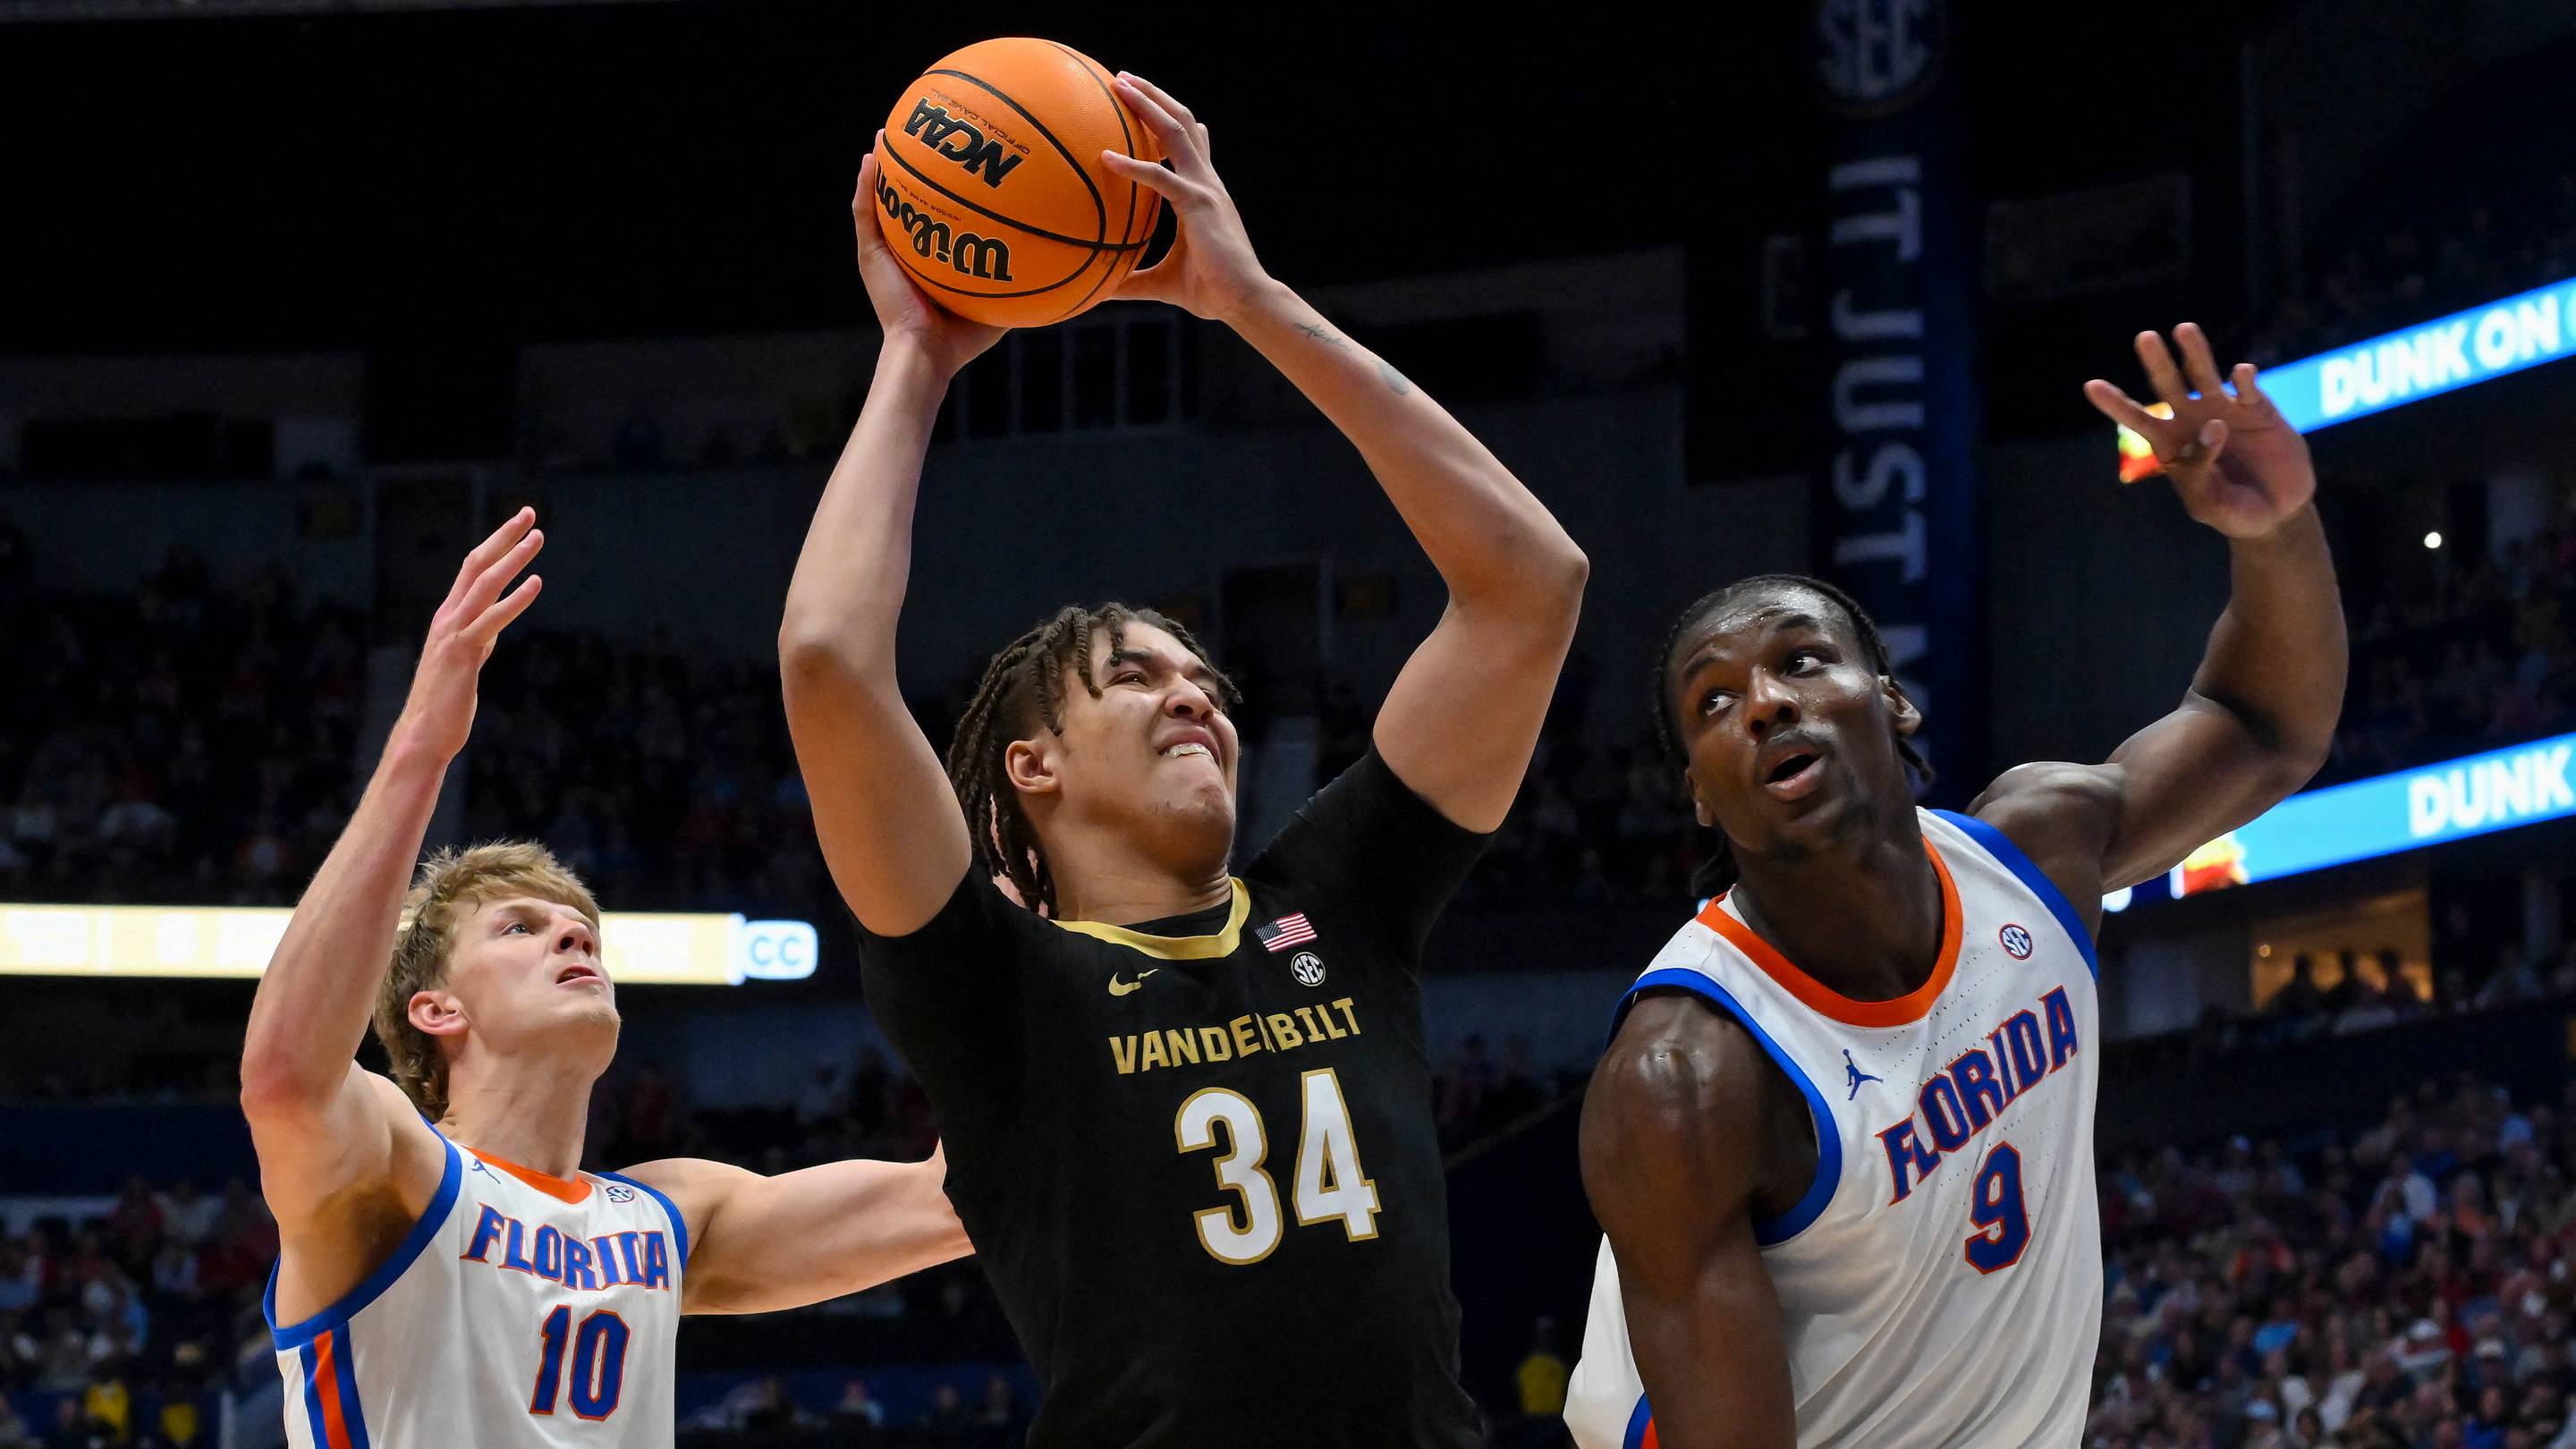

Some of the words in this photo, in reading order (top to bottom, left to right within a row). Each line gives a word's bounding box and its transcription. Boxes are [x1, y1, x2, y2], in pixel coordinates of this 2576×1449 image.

[903, 95, 1024, 191] NCAA
[949, 100, 979, 123] GAME
[979, 118, 1031, 157] OFFICIAL
[875, 159, 1013, 283] Wilson
[930, 202, 962, 223] INDOOR
[1828, 154, 1923, 266] IT
[2320, 326, 2469, 418] DUNK
[2475, 293, 2561, 366] ON
[1830, 287, 1929, 585] JUST
[2408, 742, 2572, 837] DUNK
[750, 935, 802, 967] CC
[1294, 953, 1325, 983] SEC
[2001, 927, 2031, 957] SEC
[1108, 996, 1362, 1075] VANDEBILT
[1875, 985, 2078, 1207] FLORIDA
[1174, 1067, 1383, 1266] 34
[1964, 1140, 2031, 1275] 9
[530, 1304, 631, 1421] 10
